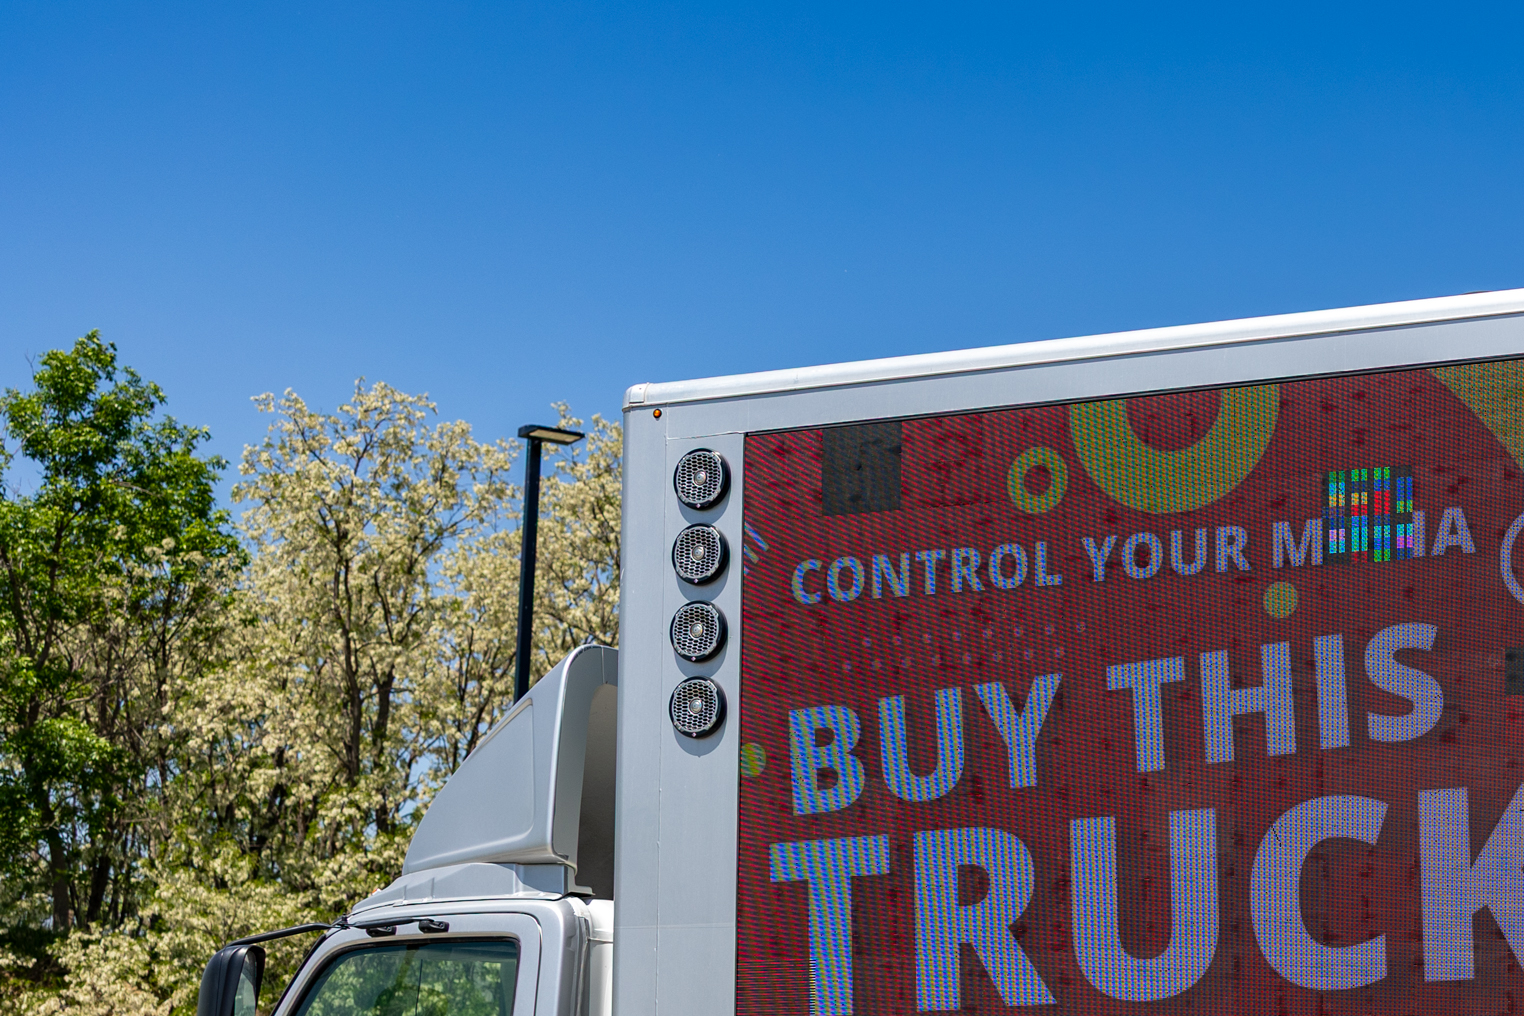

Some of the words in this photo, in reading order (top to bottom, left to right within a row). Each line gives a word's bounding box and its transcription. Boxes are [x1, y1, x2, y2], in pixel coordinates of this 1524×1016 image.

[791, 540, 1063, 605] CONTROL
[1081, 523, 1251, 584] YOUR
[1272, 507, 1476, 569] MIA
[788, 673, 1064, 816] BUY
[1106, 621, 1445, 773] THIS
